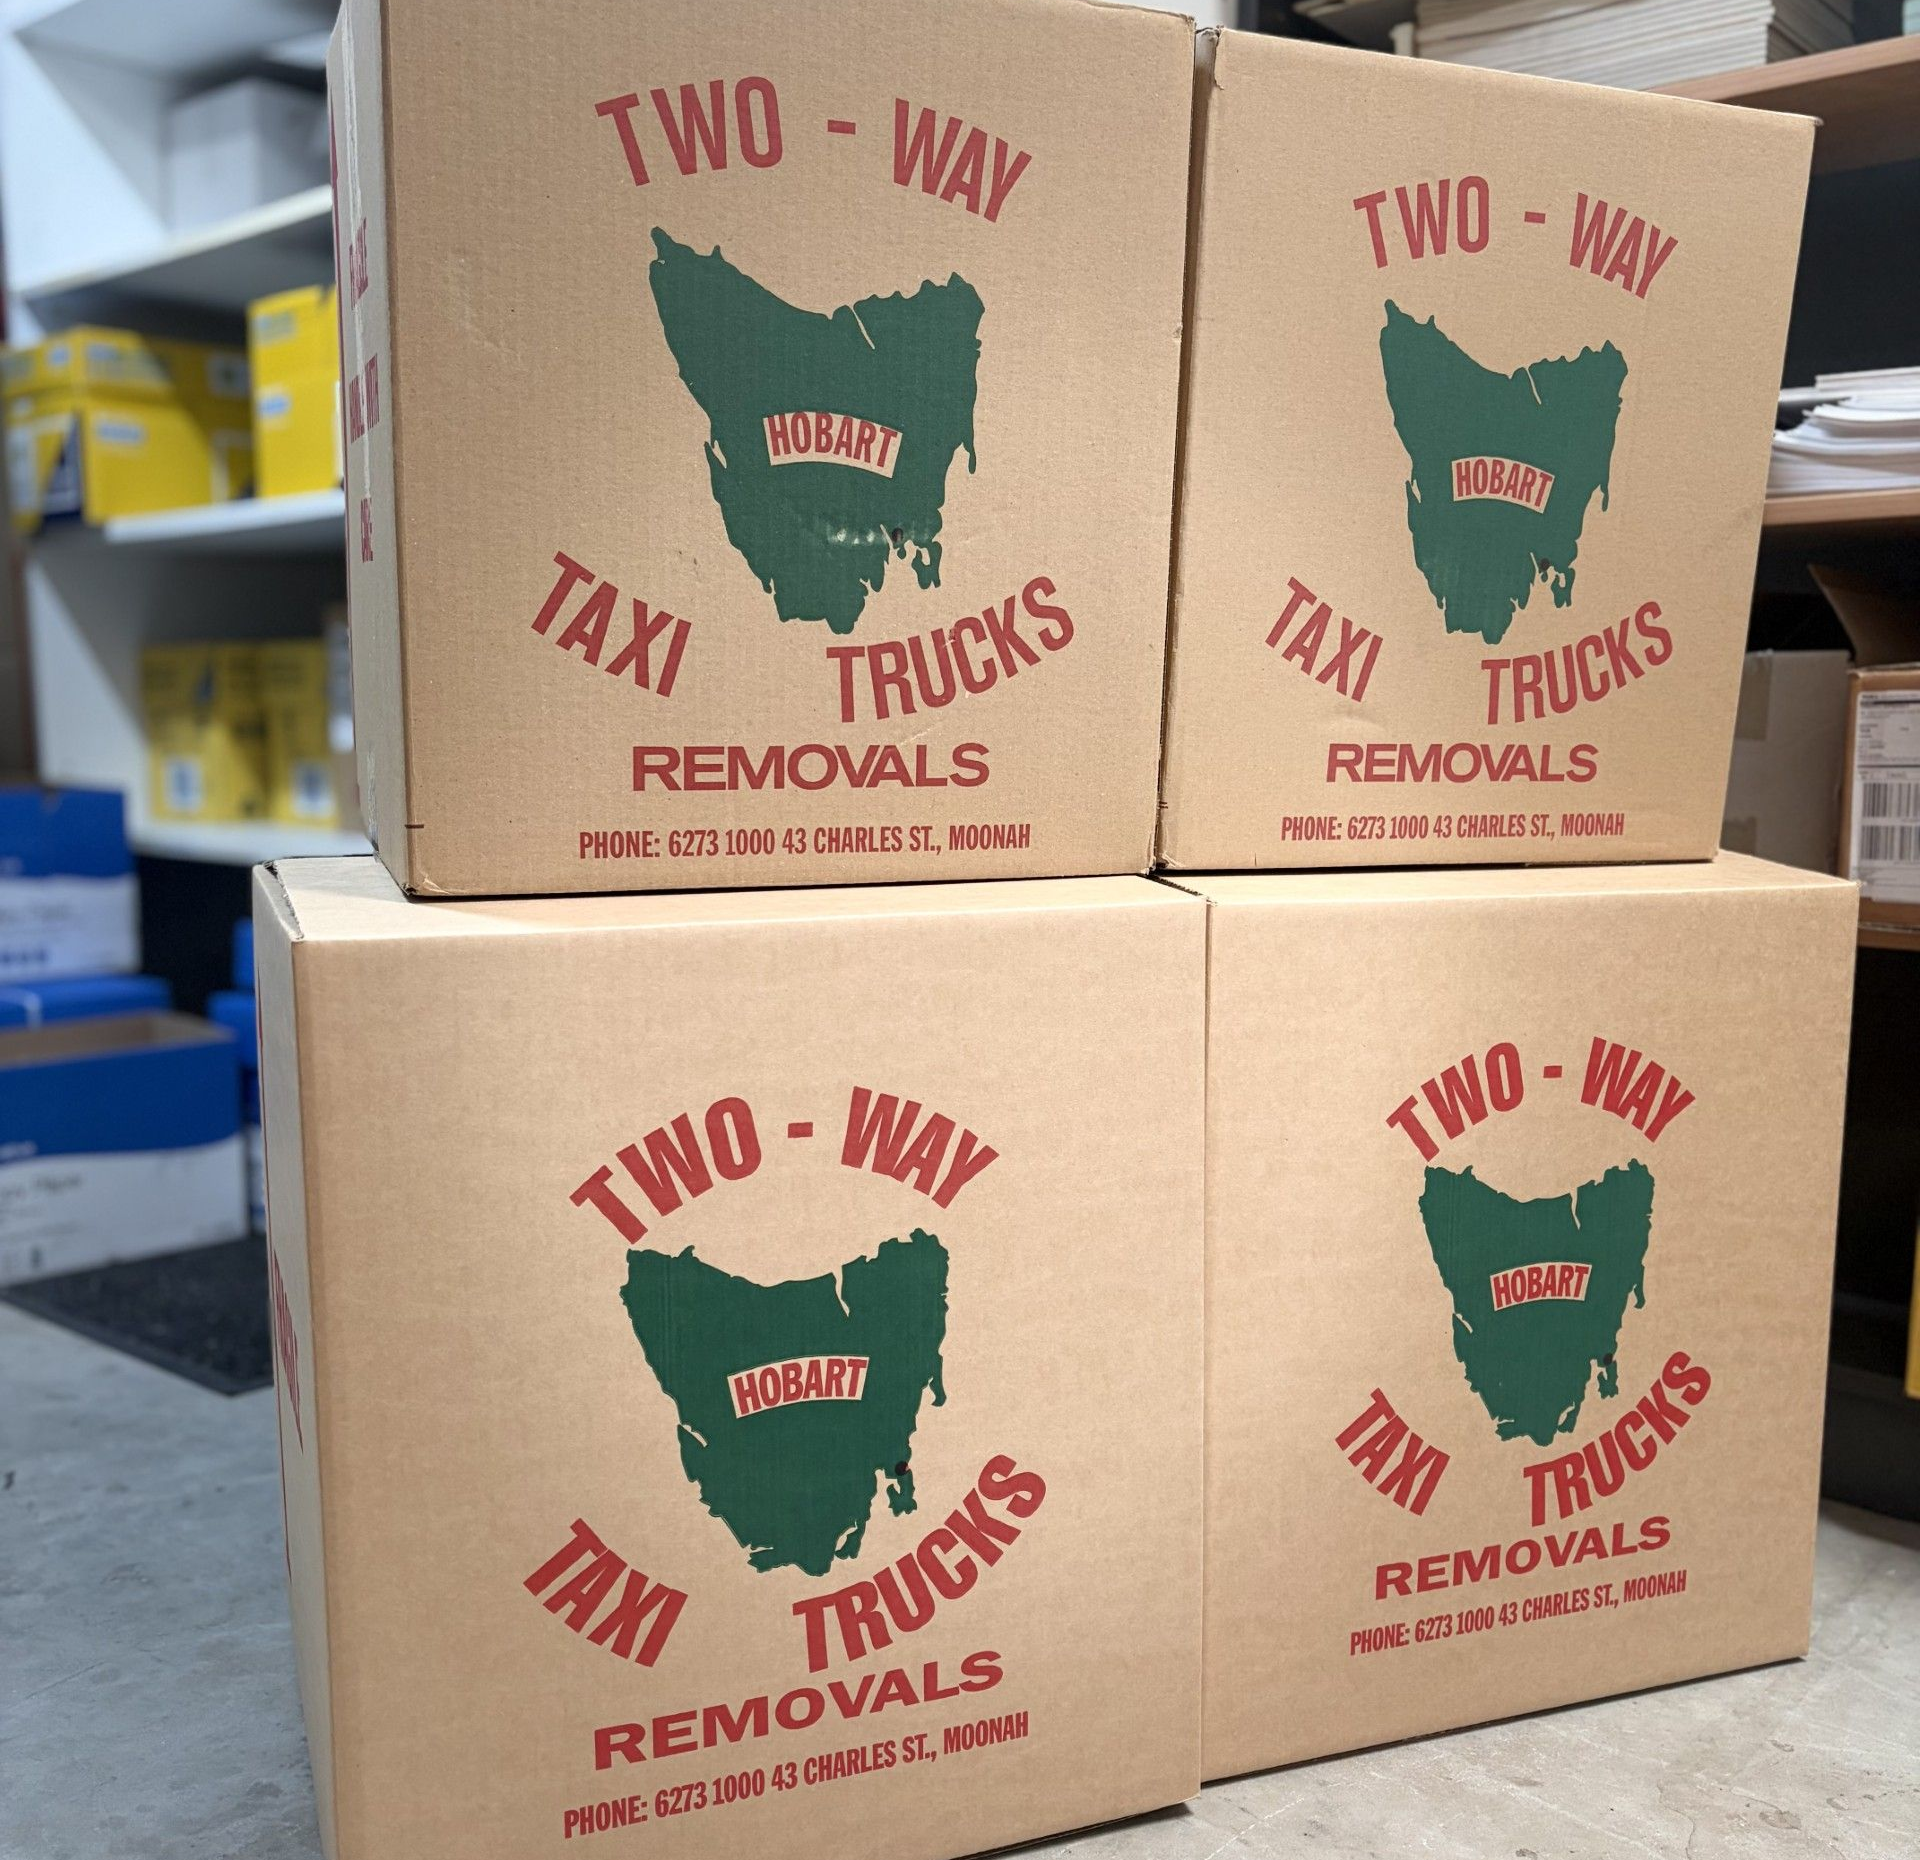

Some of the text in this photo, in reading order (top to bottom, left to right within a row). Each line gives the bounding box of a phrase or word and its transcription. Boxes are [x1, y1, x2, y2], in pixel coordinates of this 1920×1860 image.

[594, 76, 784, 187] TWO
[893, 98, 1031, 222] WAY
[1353, 175, 1490, 268] TWO
[1569, 194, 1677, 299] WAY
[767, 412, 898, 468] HOBART
[1455, 458, 1552, 507] HOBART
[530, 551, 1074, 724] TAXI TRUCKS
[1265, 577, 1674, 726] TAXI TRUCKS
[632, 742, 990, 792] REMOVALS
[1326, 742, 1598, 784] REMOVALS
[579, 830, 661, 859] PHONE:
[668, 829, 720, 858] 6273
[725, 828, 776, 856] 1000
[781, 827, 807, 855] 43
[813, 826, 903, 854] CHARLES
[948, 823, 1031, 851] MOONAH
[1281, 816, 1342, 841] PHONE:
[1347, 816, 1386, 840] 6273
[1390, 815, 1429, 840] 1000
[1434, 815, 1453, 839] 43
[1456, 813, 1526, 839] CHARLES
[1560, 813, 1625, 837] MOONAH
[1385, 1042, 1525, 1162] TWO
[1580, 1036, 1697, 1144] WAY
[569, 1096, 762, 1245] TWO
[840, 1086, 999, 1210] WAY
[1492, 1264, 1590, 1309] HOBART
[733, 1358, 868, 1415] HOBART
[1334, 1350, 1712, 1528] TAXI TRUCKS
[523, 1454, 1047, 1674] TAXI TRUCKS
[1375, 1515, 1671, 1601] REMOVALS
[1349, 1621, 1411, 1656] PHONE:
[1414, 1614, 1453, 1644] 6273
[1456, 1606, 1495, 1636] 1000
[1498, 1602, 1518, 1626] 43
[1521, 1587, 1591, 1623] CHARLES
[1623, 1570, 1687, 1603] MOONAH
[593, 1650, 1004, 1771] REMOVALS
[563, 1794, 648, 1840] PHONE:
[654, 1781, 708, 1818] 6273
[712, 1768, 766, 1806] 1000
[771, 1762, 799, 1790] 43
[802, 1740, 897, 1786] CHARLES
[943, 1710, 1029, 1755] MOONAH
